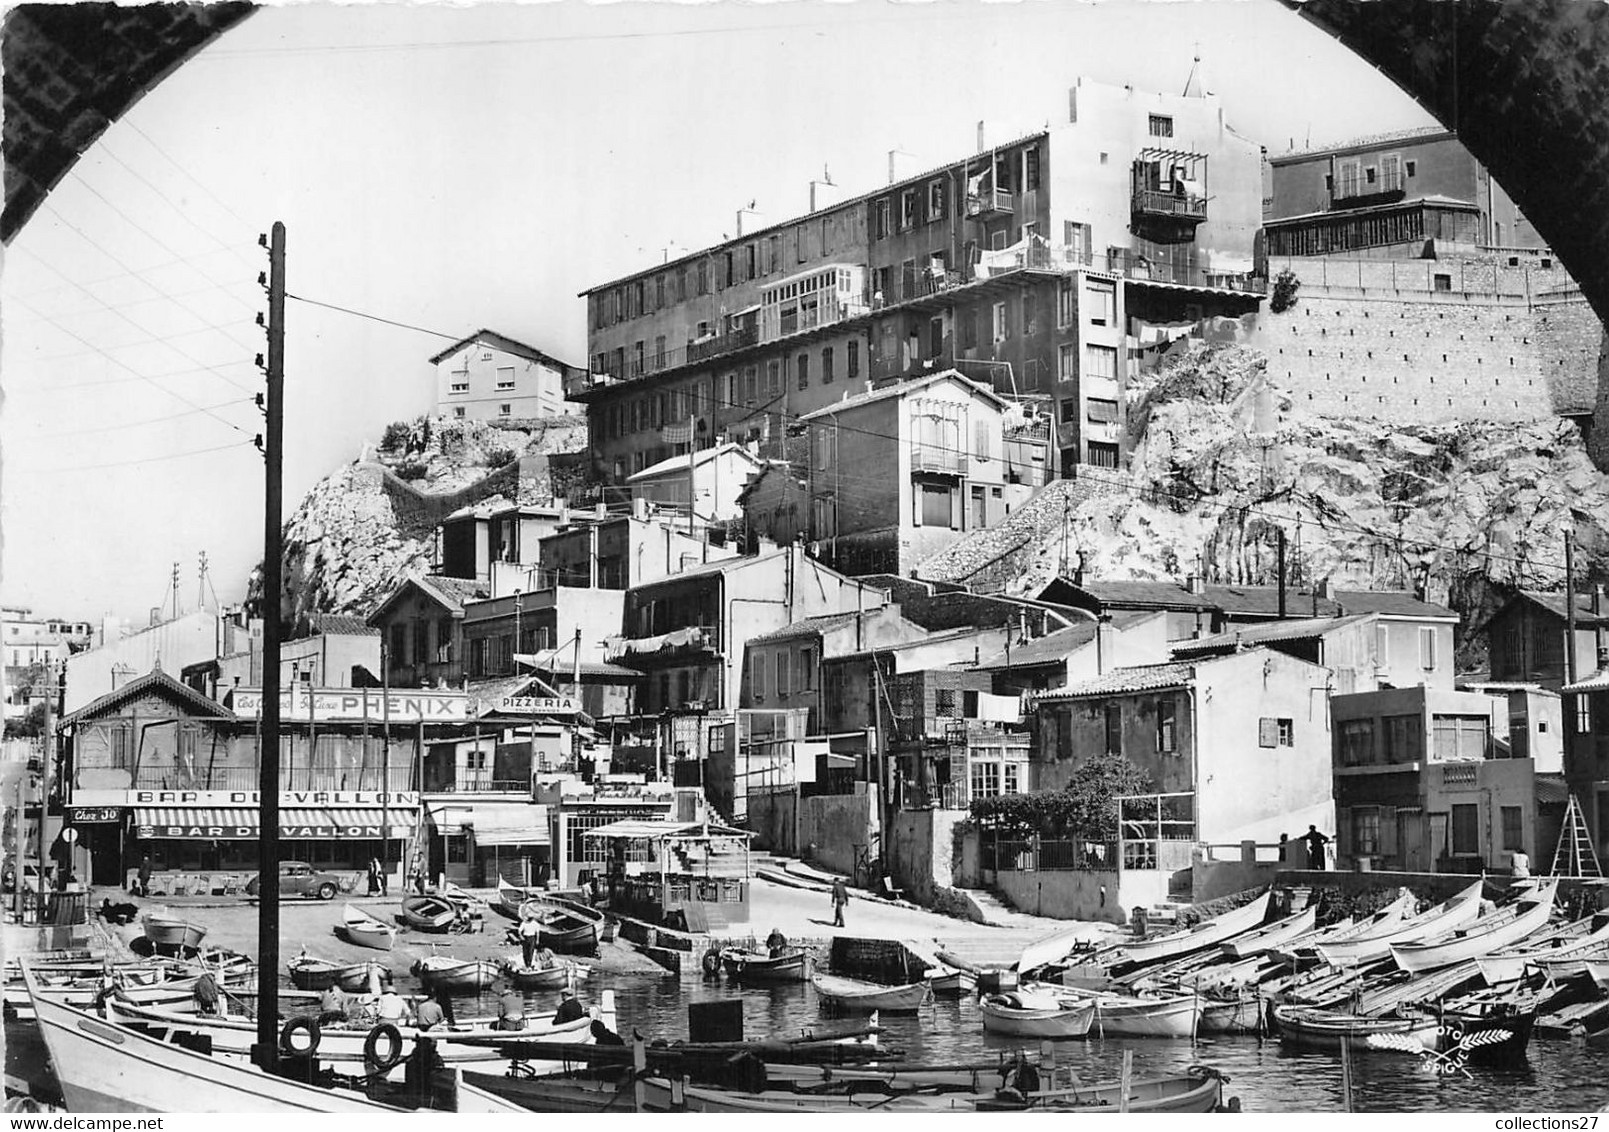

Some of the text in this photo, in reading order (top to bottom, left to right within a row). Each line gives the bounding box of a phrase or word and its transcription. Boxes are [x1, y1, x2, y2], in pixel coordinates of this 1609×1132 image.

[503, 697, 572, 708] PIZZERIA
[137, 792, 197, 803] BAR
[295, 792, 412, 803] VALLON
[75, 811, 97, 821] Chez
[168, 827, 223, 836] BAR
[282, 827, 380, 837] VALLON
